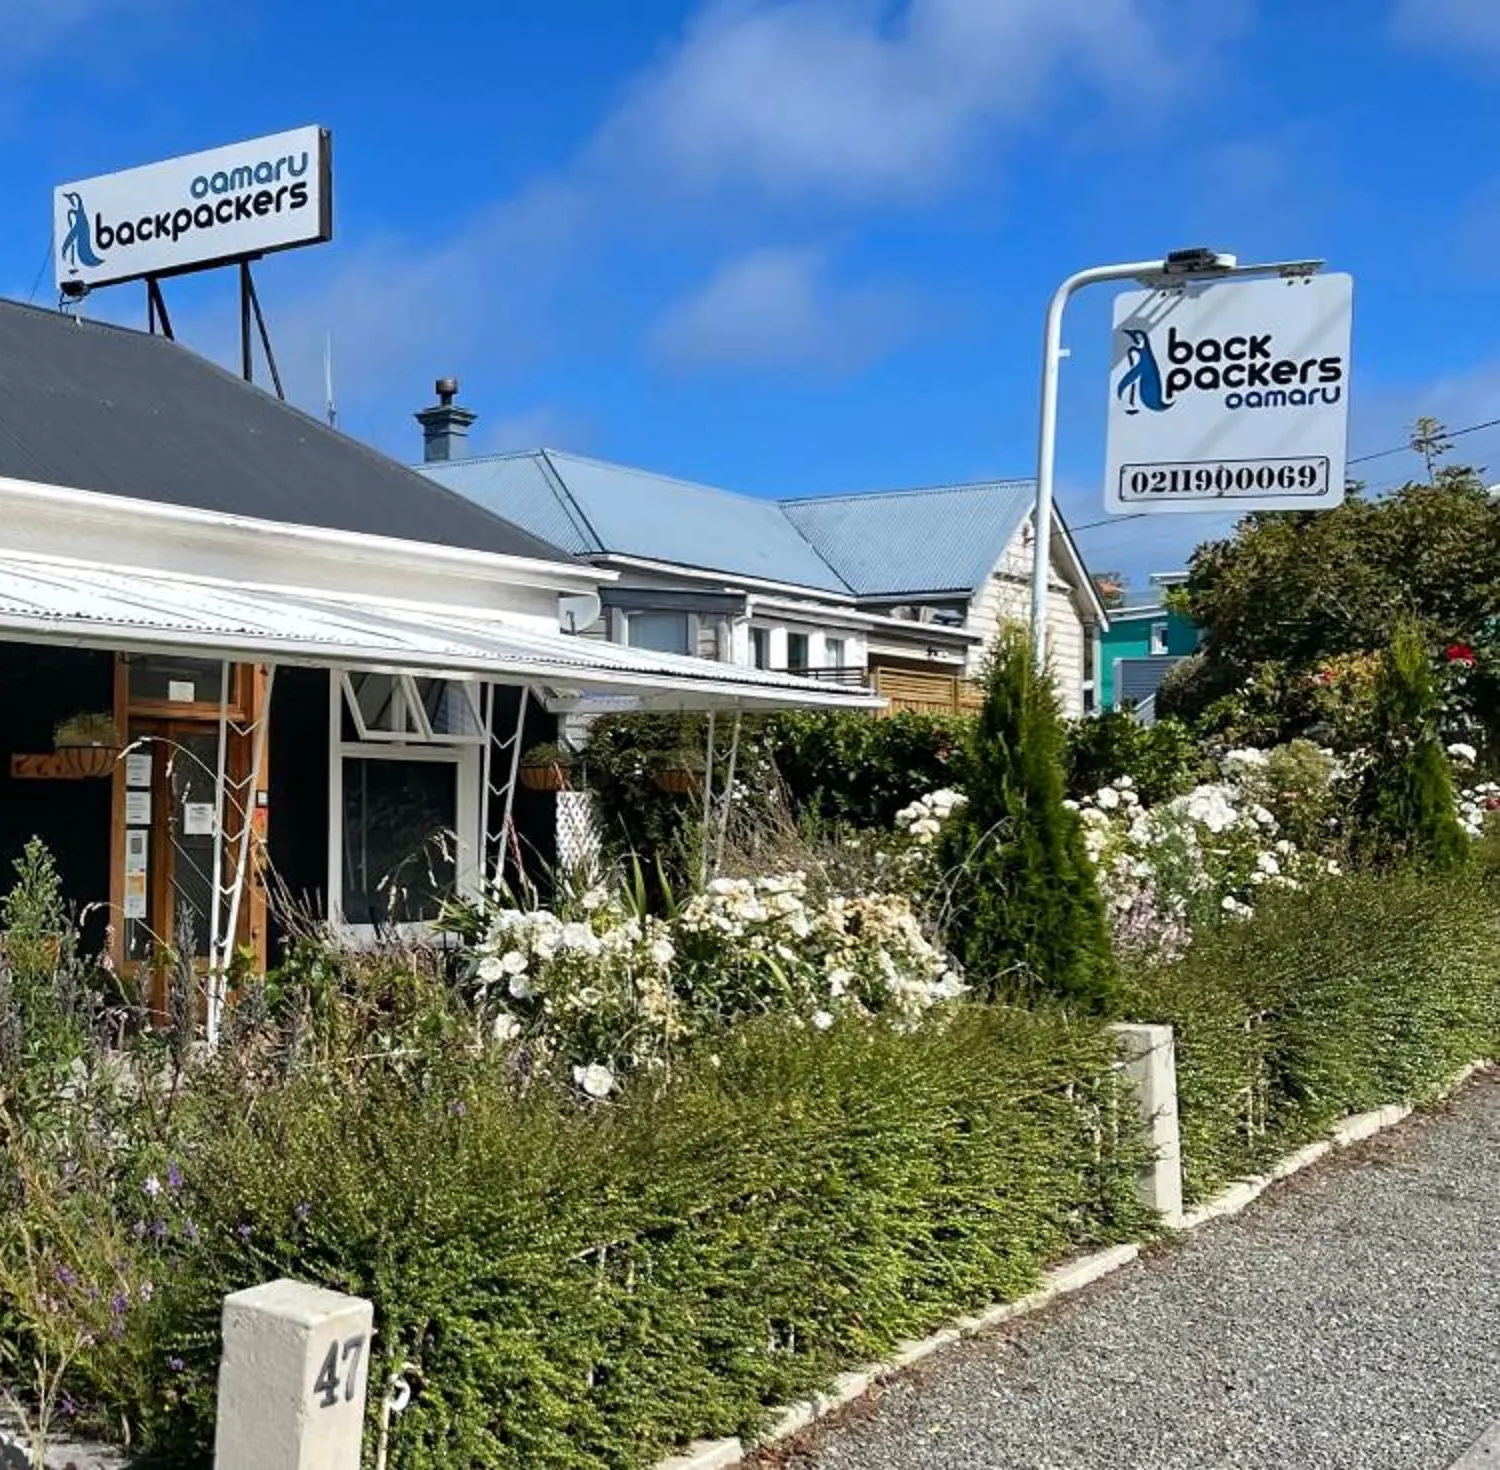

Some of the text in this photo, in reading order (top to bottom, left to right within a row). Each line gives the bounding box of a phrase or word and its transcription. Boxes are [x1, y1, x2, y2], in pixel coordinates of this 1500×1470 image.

[190, 151, 308, 199] oamaru
[95, 181, 308, 250] backpackers
[1168, 326, 1272, 364] back
[1166, 357, 1342, 400] packers
[1225, 386, 1341, 410] oamaru
[1131, 465, 1317, 493] 0211900069
[313, 1334, 367, 1409] 47
